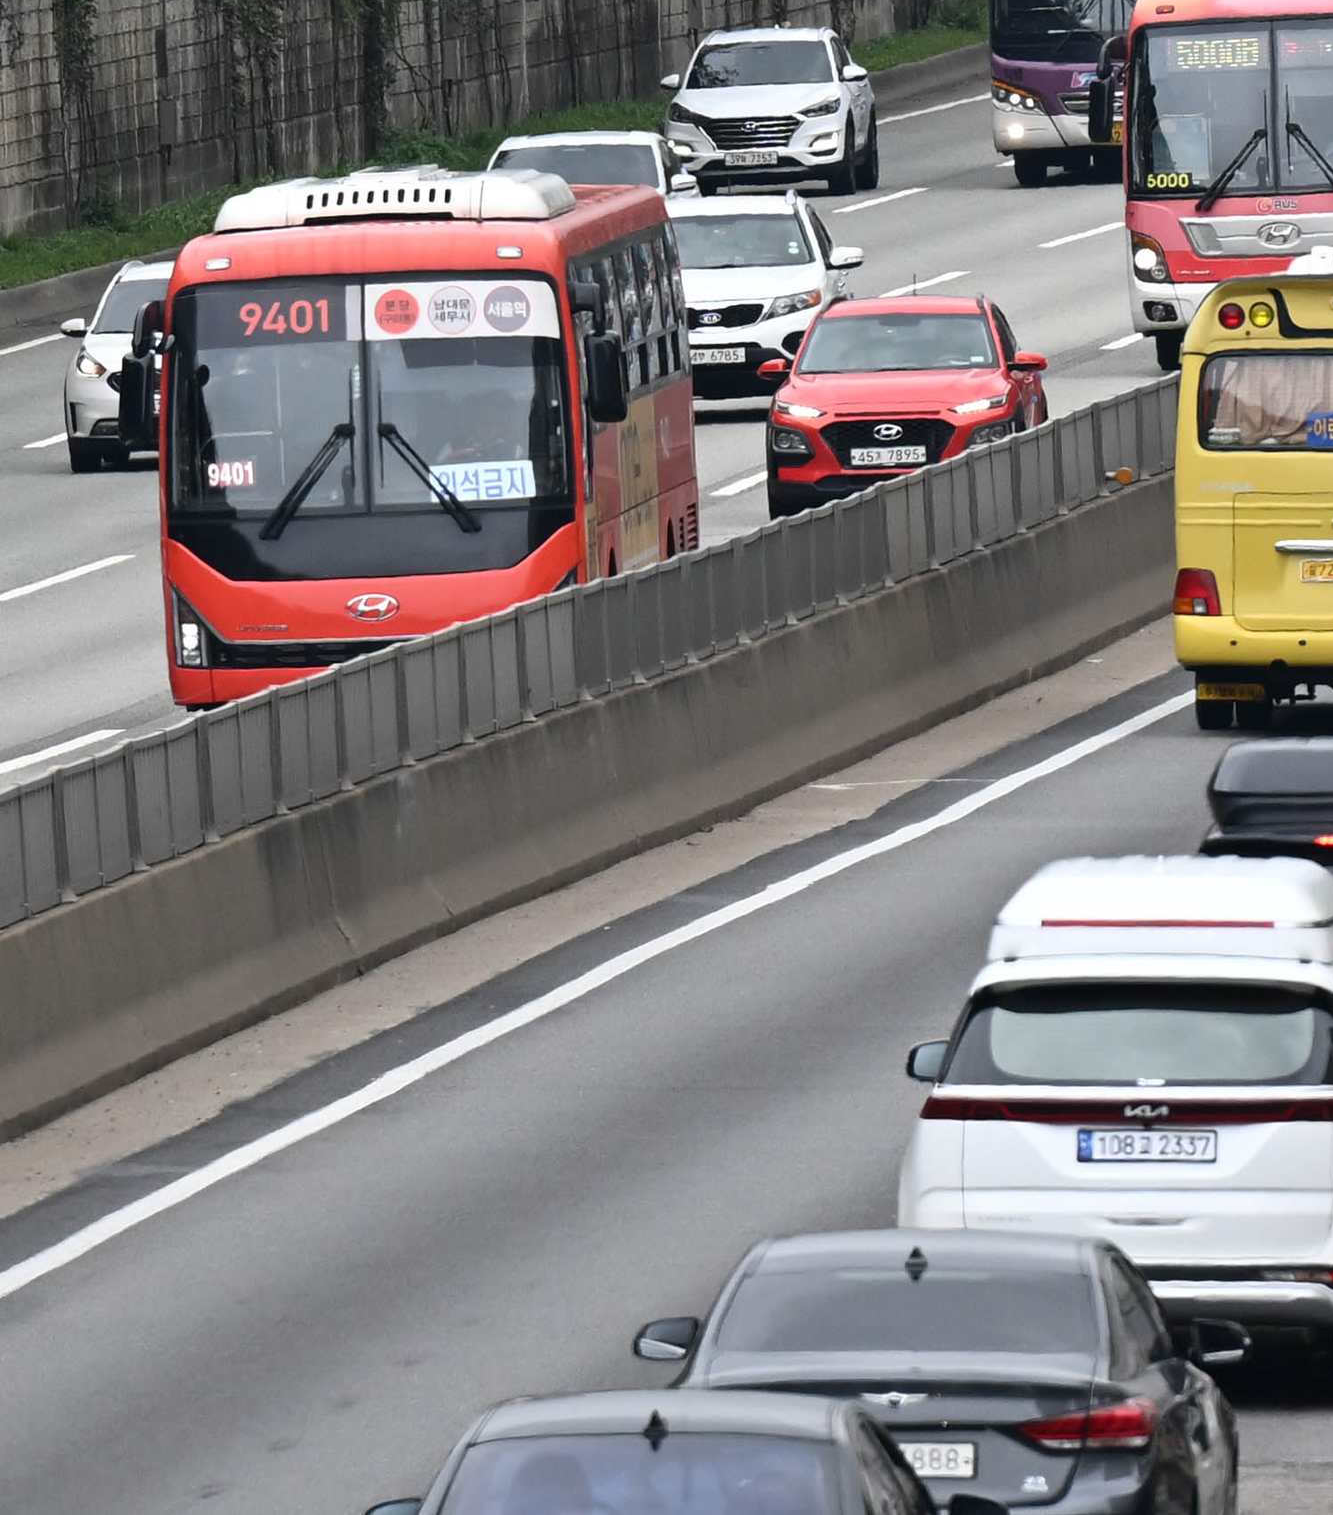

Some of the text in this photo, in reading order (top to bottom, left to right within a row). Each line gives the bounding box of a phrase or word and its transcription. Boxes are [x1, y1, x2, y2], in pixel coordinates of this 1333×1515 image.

[434, 299, 471, 312] 남대문
[488, 301, 527, 318] 서울역
[239, 299, 330, 335] 9401
[434, 311, 471, 323] 세무서
[711, 350, 739, 362] 6785
[887, 448, 921, 461] 7895
[207, 461, 254, 486] 9401
[1159, 1135, 1211, 1156] 2337
